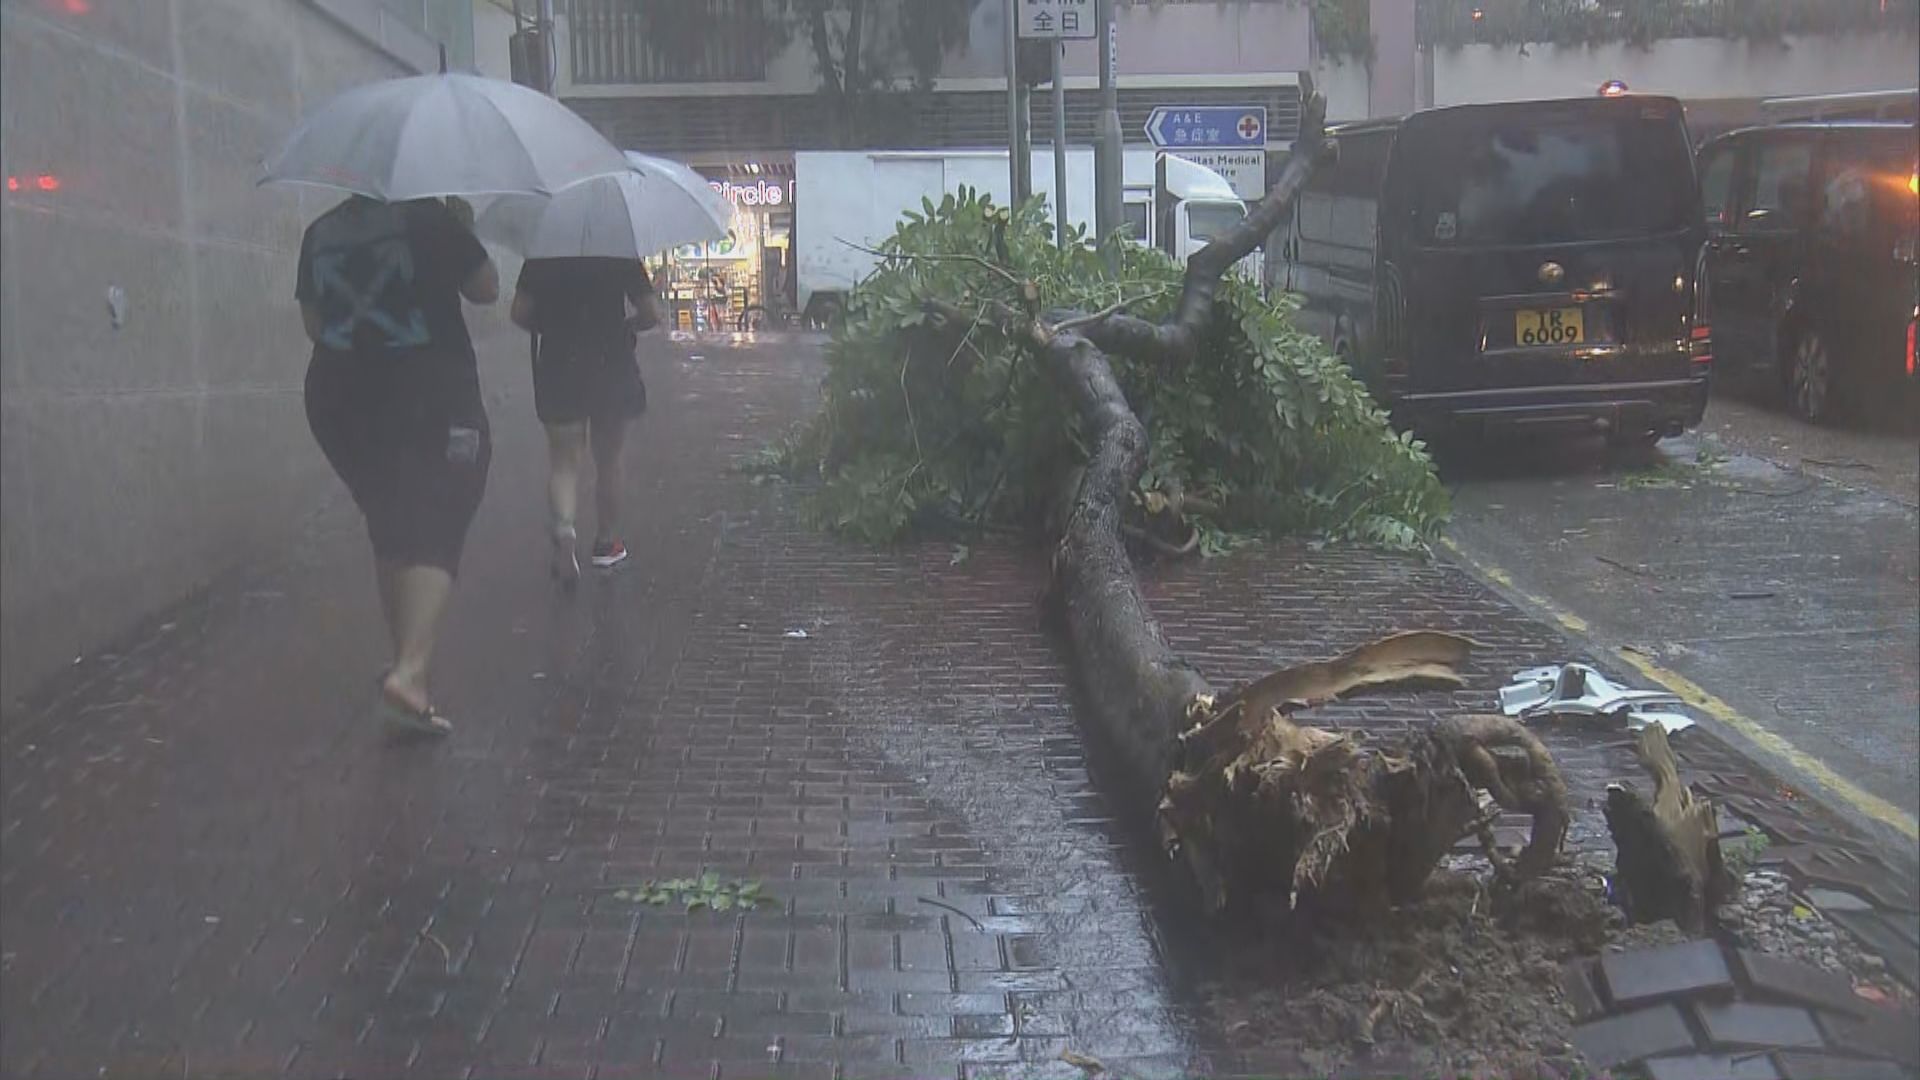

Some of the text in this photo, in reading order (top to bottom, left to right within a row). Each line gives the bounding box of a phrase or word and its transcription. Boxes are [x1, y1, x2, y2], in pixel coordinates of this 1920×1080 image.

[1033, 10, 1078, 31] 全日
[1173, 112, 1202, 123] A & E
[1218, 155, 1260, 165] Medical
[1523, 326, 1578, 343] 6009
